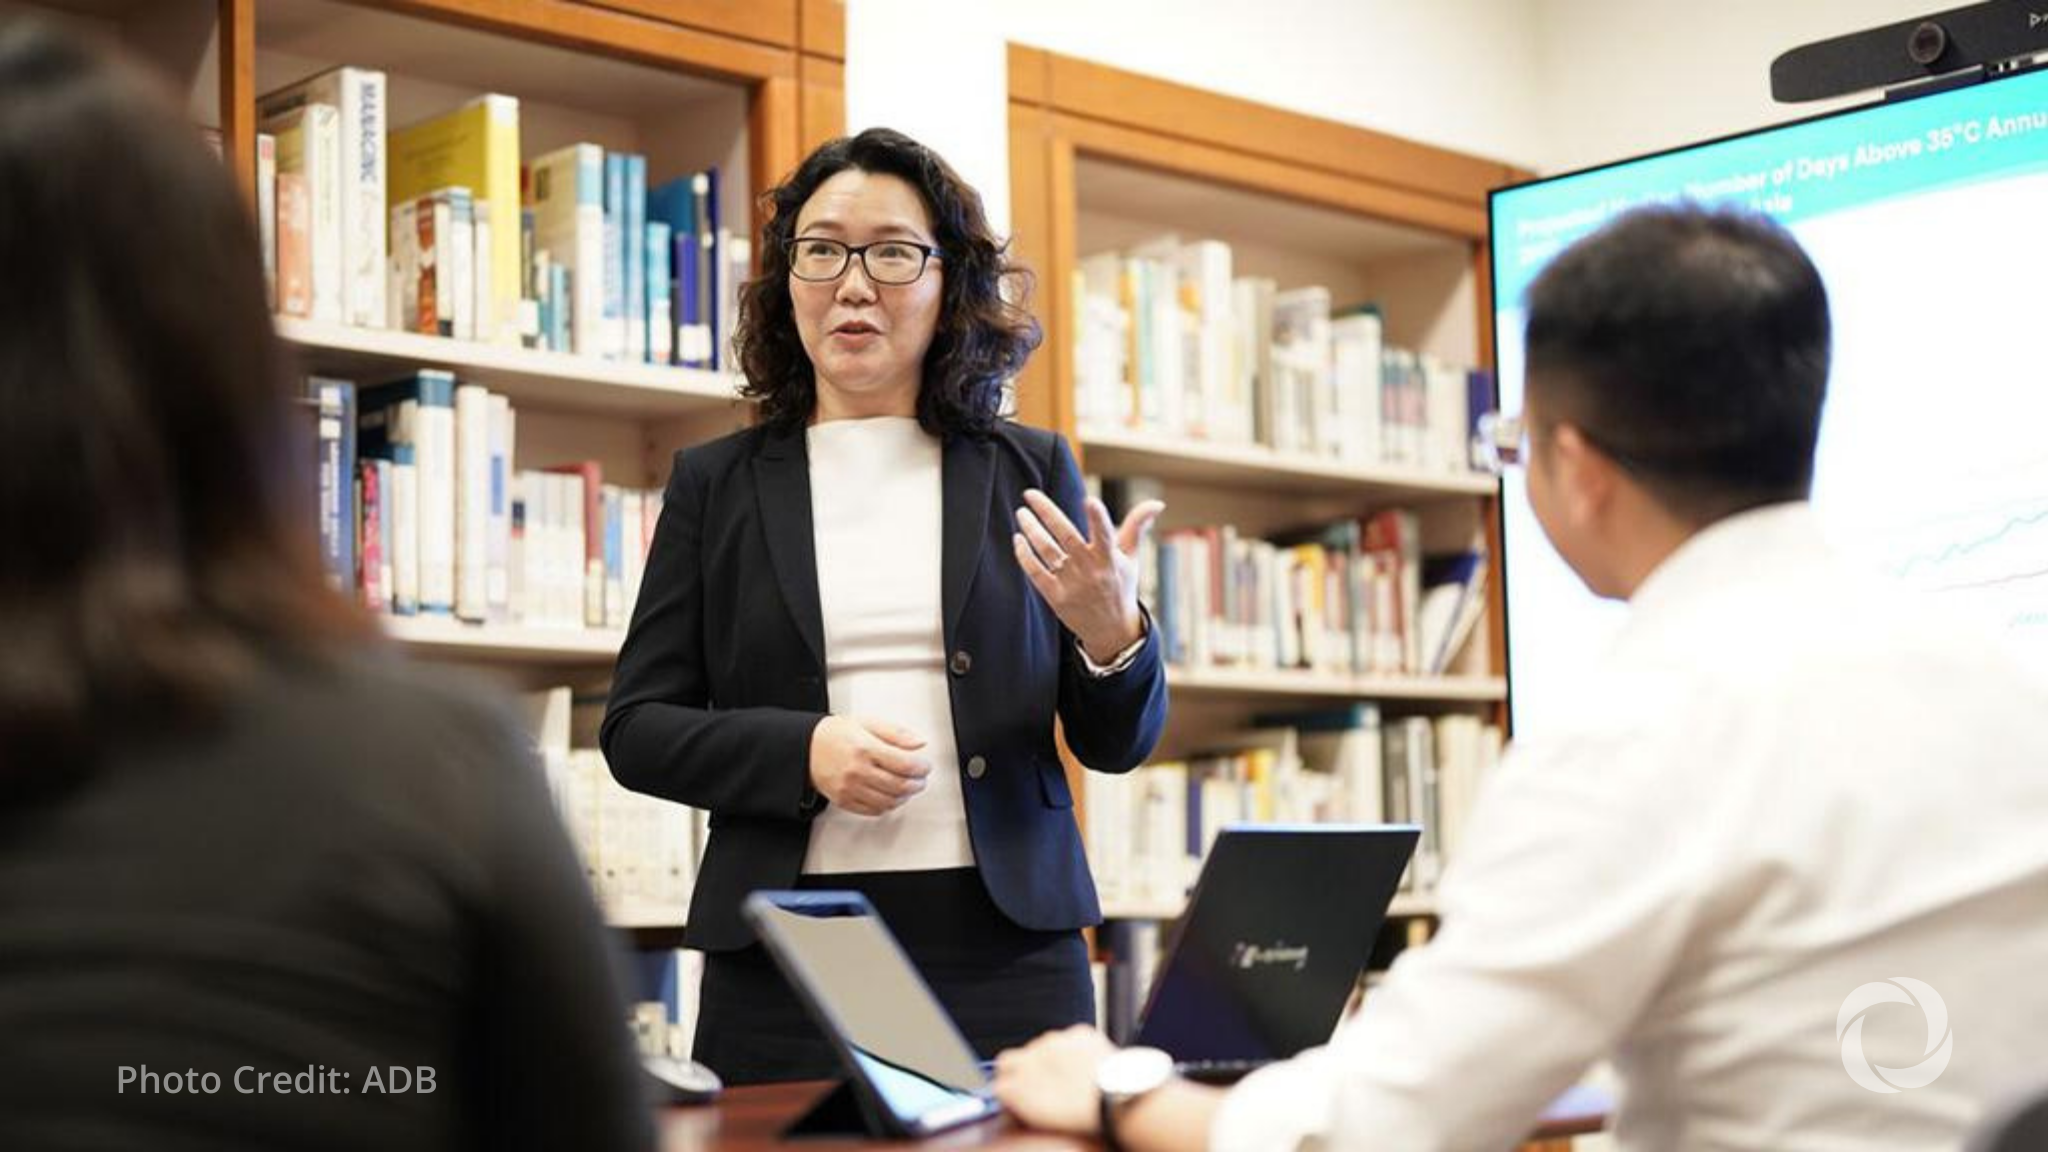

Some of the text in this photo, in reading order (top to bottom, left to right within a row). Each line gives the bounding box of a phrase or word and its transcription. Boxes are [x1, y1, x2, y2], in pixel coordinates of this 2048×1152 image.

[1772, 160, 1793, 186] of
[1798, 154, 1850, 180] Days
[1854, 137, 1923, 167] Above
